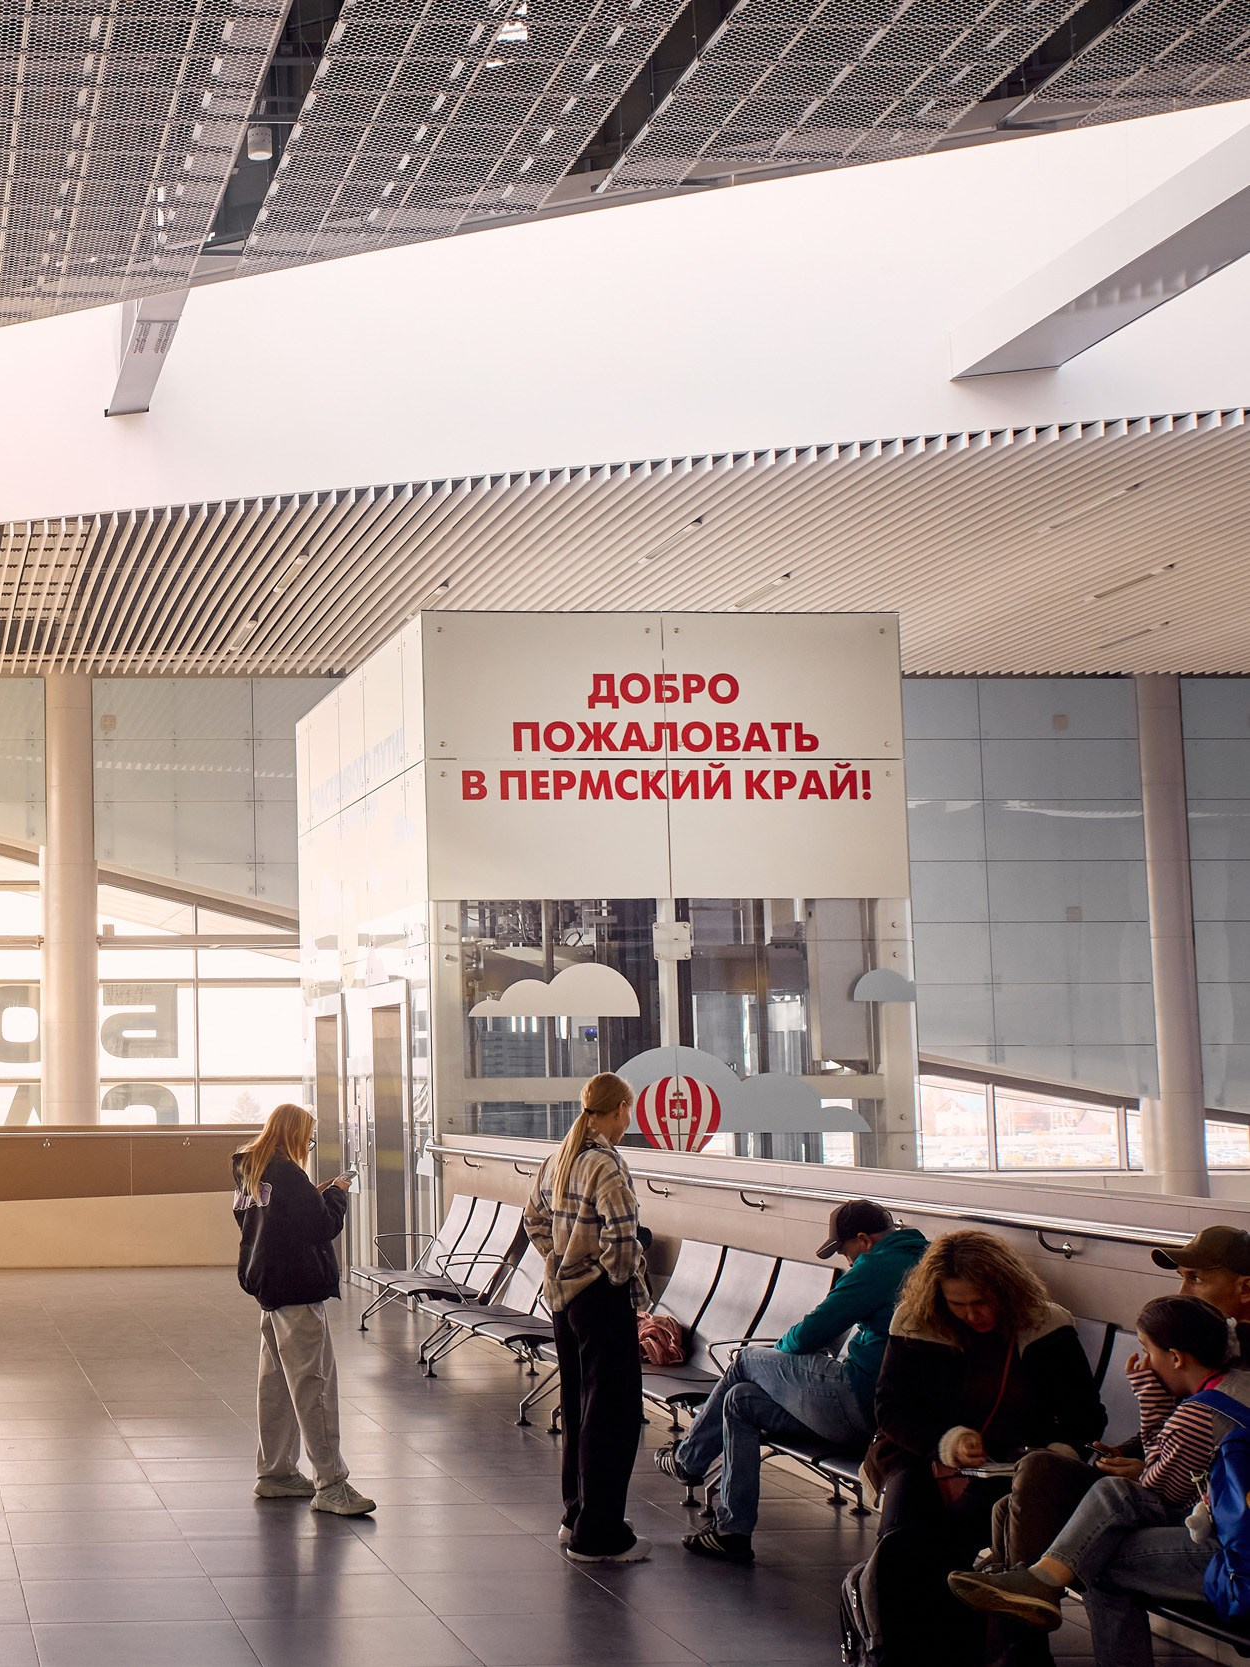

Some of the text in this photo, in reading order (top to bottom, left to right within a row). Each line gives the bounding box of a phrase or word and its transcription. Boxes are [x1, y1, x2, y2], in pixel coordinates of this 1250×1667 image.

[588, 673, 740, 709] ДОБРО
[513, 721, 820, 753] ПОЖАЛОВАТЬ
[461, 762, 872, 801] В ПЕРМСКИЙ КРАЙ!
